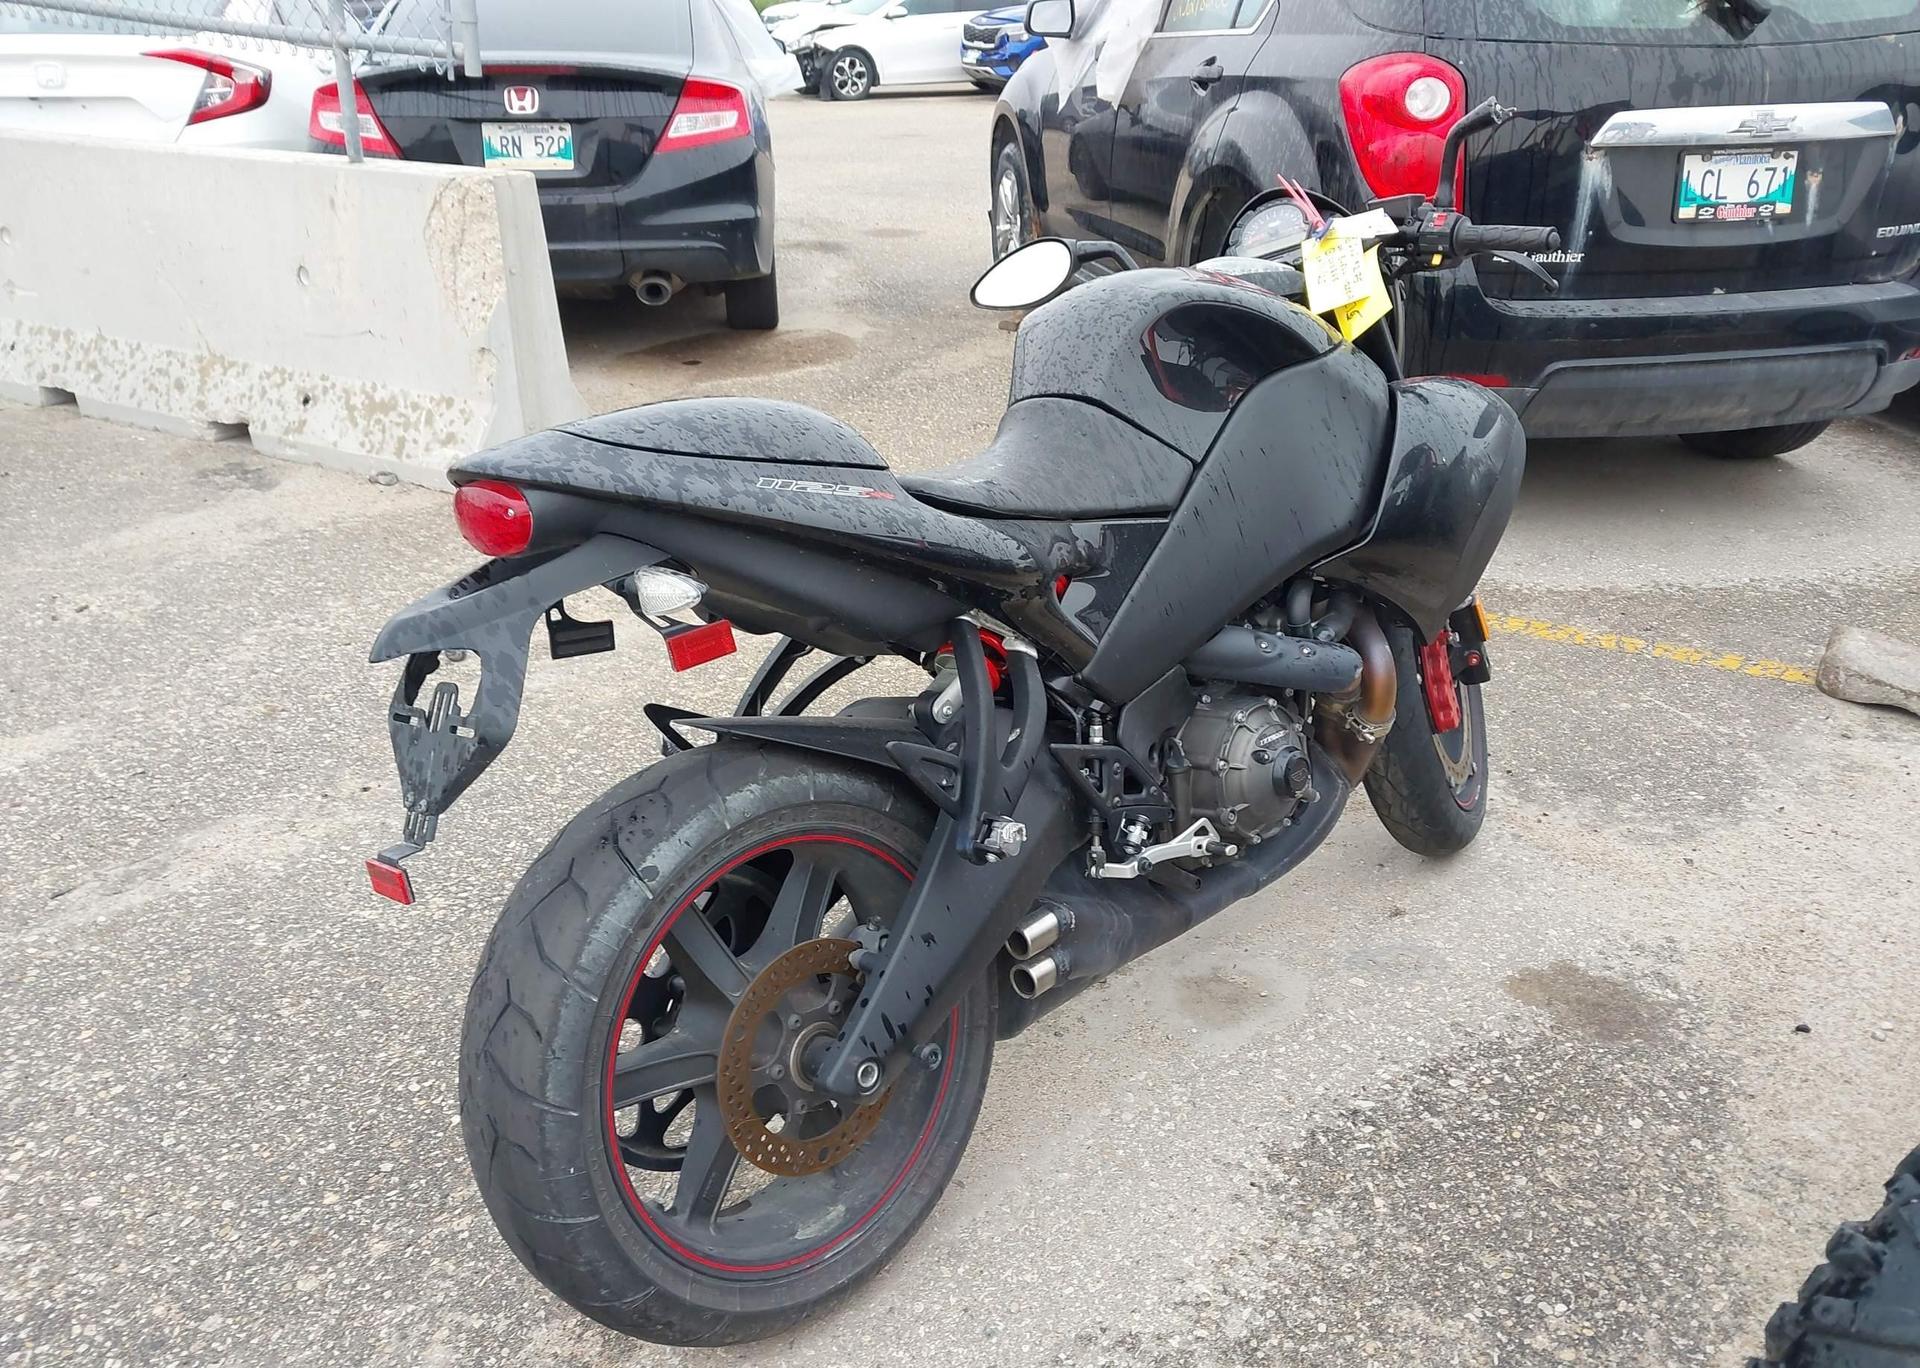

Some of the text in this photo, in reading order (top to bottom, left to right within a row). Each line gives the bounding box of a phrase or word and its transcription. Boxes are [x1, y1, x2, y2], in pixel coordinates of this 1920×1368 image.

[487, 135, 570, 159] LRN 520
[1684, 166, 1788, 201] LCL 671
